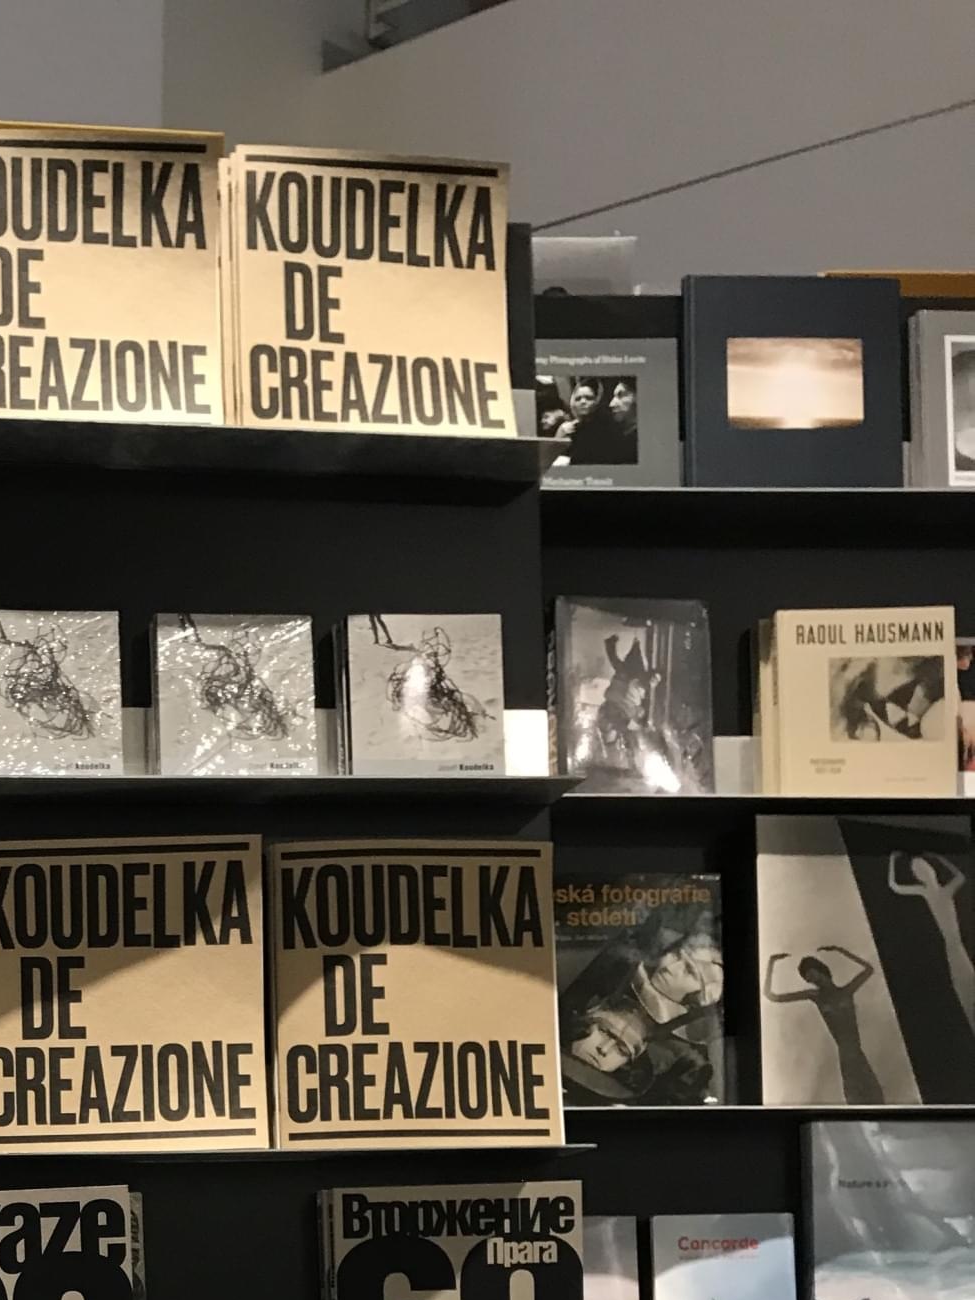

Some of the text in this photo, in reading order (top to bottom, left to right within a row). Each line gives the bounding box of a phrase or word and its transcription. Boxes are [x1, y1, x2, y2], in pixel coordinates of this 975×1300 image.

[245, 170, 496, 271] KOUDELKA
[284, 261, 345, 344] DE
[249, 344, 505, 429] CREAZIONE
[795, 620, 944, 645] RAOUL HAUSMANN
[281, 864, 543, 949] KOUDELKA
[553, 884, 711, 907] ská fotografie
[20, 956, 87, 1041] DE
[323, 953, 389, 1037] DE
[286, 1040, 550, 1124] CREAZIONE
[342, 1193, 574, 1240] Вторжение
[487, 1236, 558, 1267] Прага
[678, 1235, 760, 1252] Concorde
